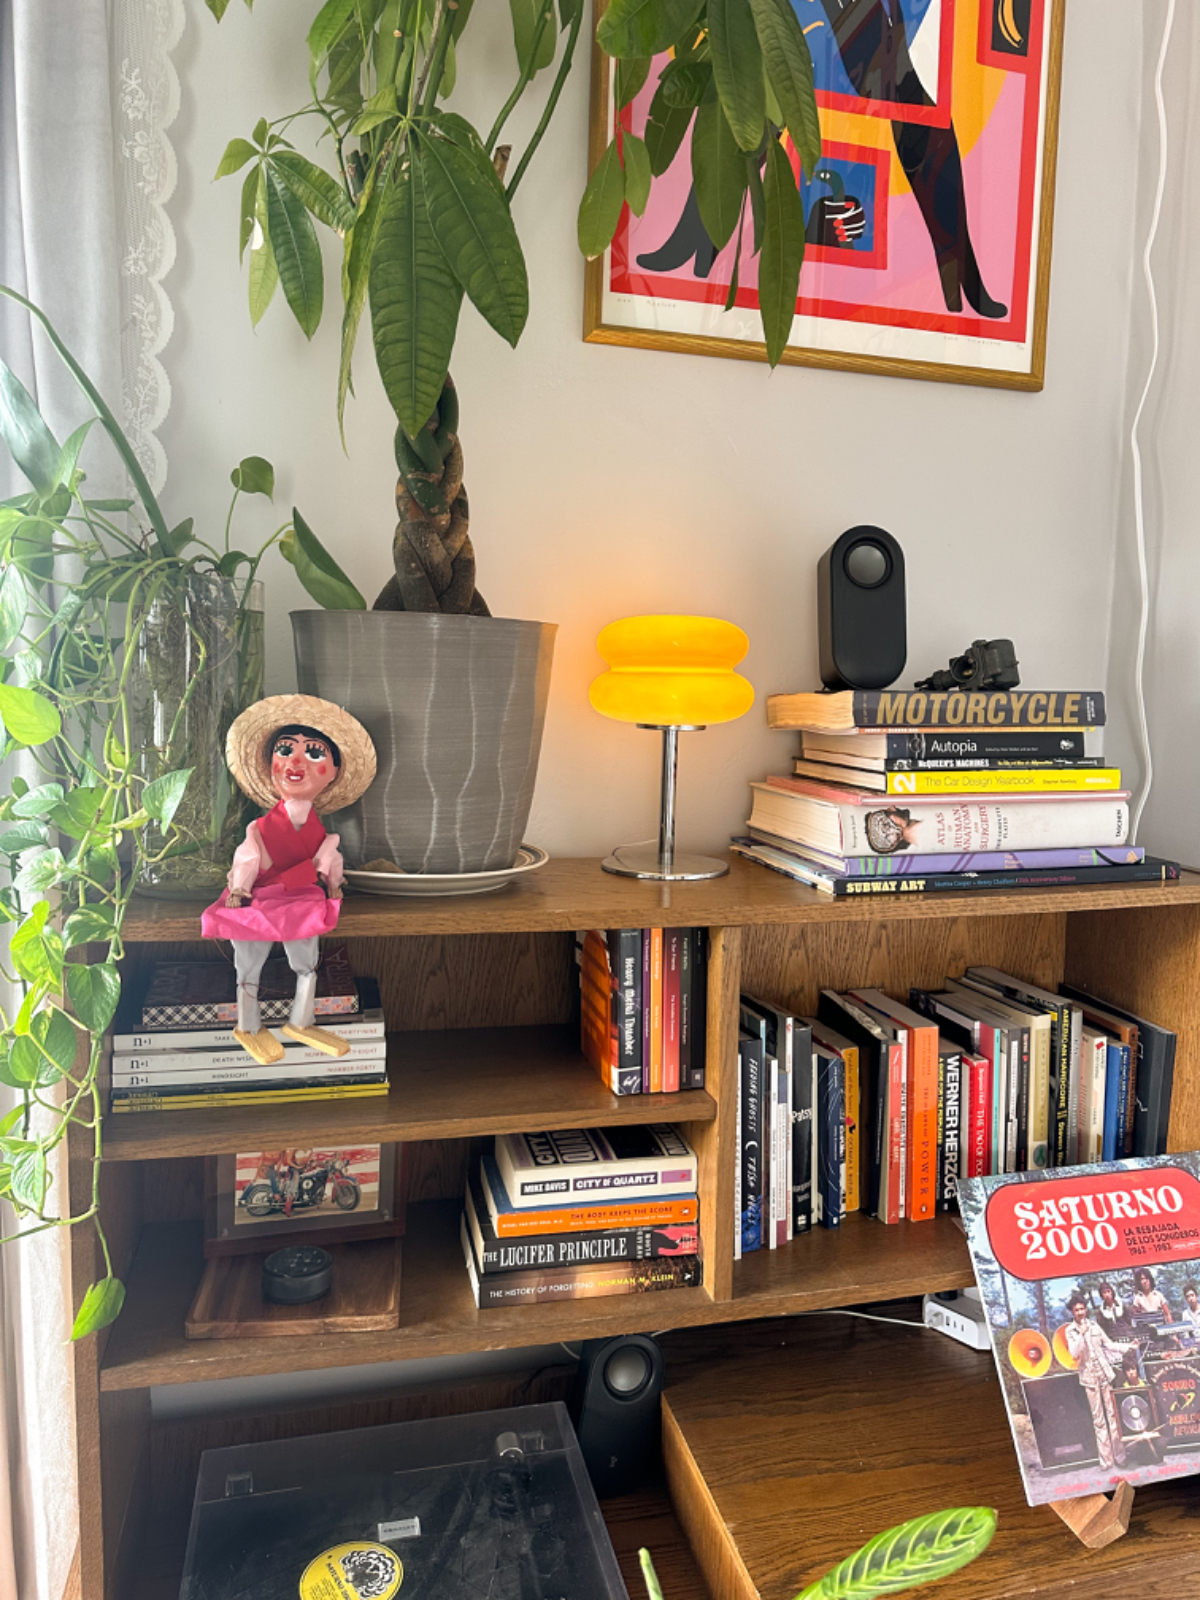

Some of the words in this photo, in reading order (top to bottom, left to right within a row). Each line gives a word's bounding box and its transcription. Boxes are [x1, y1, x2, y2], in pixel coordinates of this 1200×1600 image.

[876, 692, 1081, 725] MOTORCYCLE
[931, 739, 977, 756] Autopia
[956, 758, 989, 768] MACHINES
[893, 773, 916, 793] 2
[925, 775, 942, 787] The
[944, 775, 961, 787] Car
[964, 775, 993, 789] Design
[994, 774, 1035, 786] Yearbook
[936, 812, 946, 845] ATLAS
[952, 808, 963, 848] HUMAN
[960, 803, 971, 852] ANATOMY
[978, 804, 990, 850] SURGERY
[846, 881, 897, 893] SUBWAY
[900, 880, 926, 891] ART
[133, 1038, 152, 1047] n+1
[1060, 1009, 1069, 1057] AMERICAN
[130, 1060, 148, 1069] n+1
[130, 1076, 148, 1085] n+1
[749, 1058, 758, 1094] FEEDING
[1059, 1058, 1068, 1108] HARDCORE
[945, 1055, 959, 1128] WERNER
[748, 1097, 758, 1132] GHOSTS
[976, 1109, 984, 1127] THE
[555, 1130, 597, 1162] QUAR
[976, 1129, 984, 1145] TAO
[531, 1137, 556, 1164] CITY
[976, 1146, 984, 1156] OF
[920, 1140, 930, 1195] POWER
[943, 1130, 958, 1199] HERZOG
[523, 1184, 544, 1194] MIKE
[544, 1182, 567, 1192] DAVIS
[576, 1178, 601, 1190] CITY
[613, 1174, 656, 1186] QUARTZ
[650, 1206, 673, 1214] SCORE
[1013, 1185, 1184, 1231] SATURNO
[1124, 1228, 1135, 1236] LA
[1136, 1223, 1180, 1234] REBAJADA
[1126, 1237, 1138, 1246] DE
[1138, 1234, 1154, 1244] LOS
[1156, 1228, 1199, 1242] SONIDEROS
[1020, 1220, 1119, 1260] 2000
[483, 1252, 498, 1262] THE
[500, 1244, 555, 1268] LUCIFER
[559, 1238, 628, 1262] PRINCIPLE
[490, 1290, 503, 1298] THE
[504, 1286, 536, 1296] HISTORY
[548, 1281, 594, 1292] FORGETTING
[598, 1277, 636, 1287] NORMAN
[651, 1274, 674, 1282] KLEIN
